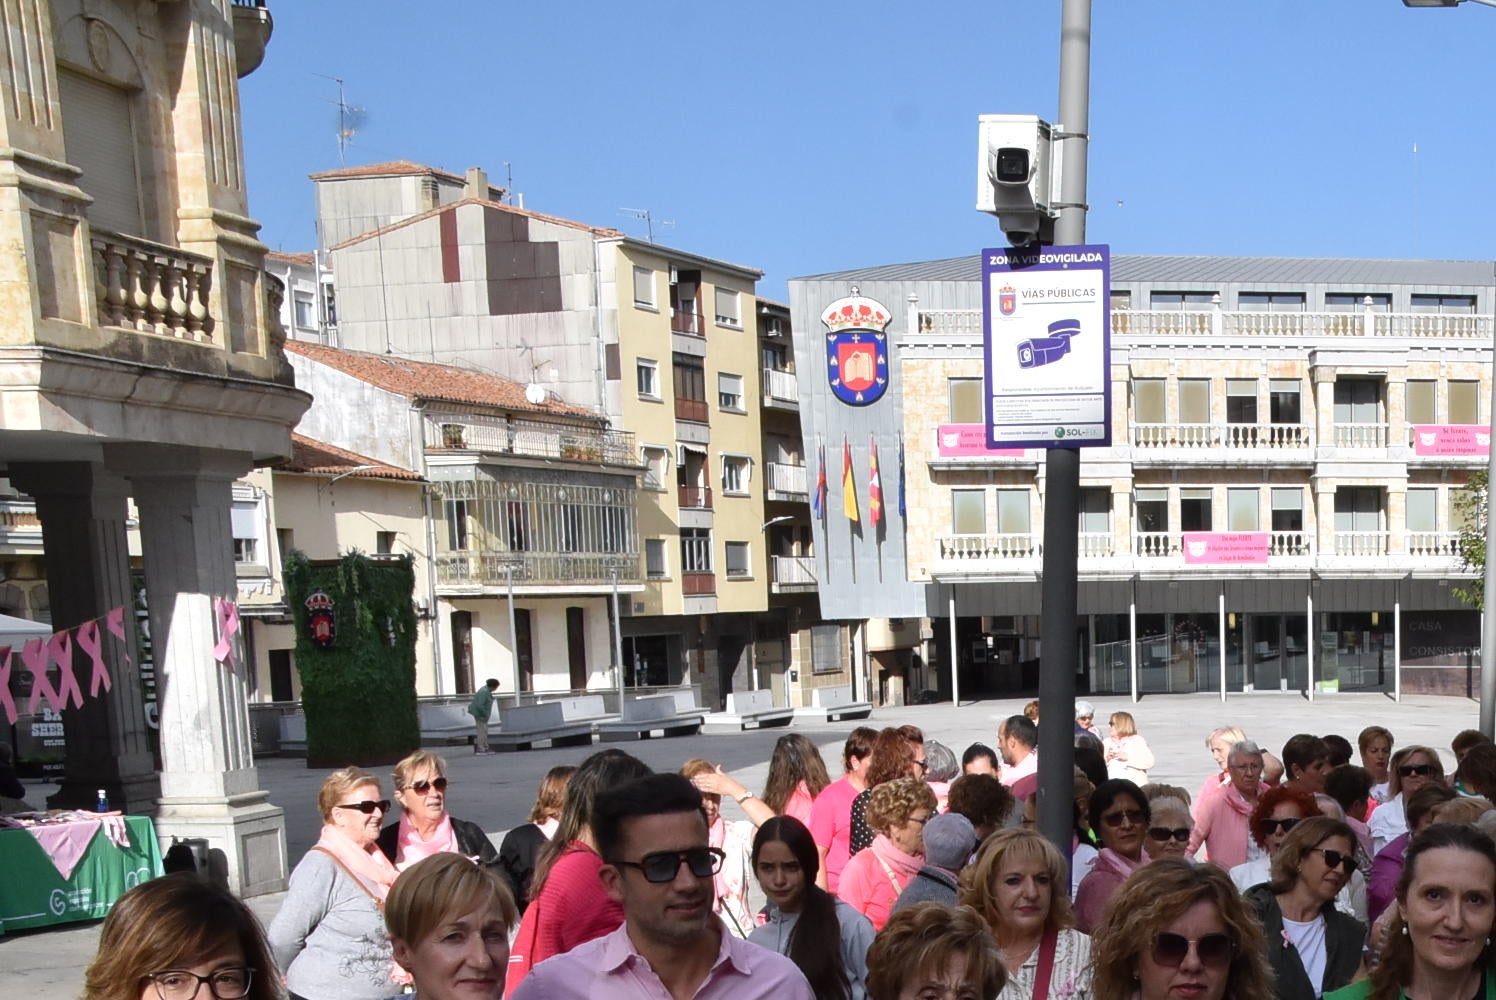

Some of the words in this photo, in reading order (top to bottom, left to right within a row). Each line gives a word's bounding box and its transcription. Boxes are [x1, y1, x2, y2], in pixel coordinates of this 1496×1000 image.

[990, 255, 1020, 265] ZONA
[1021, 252, 1103, 264] VIDEOVIGILADA
[1047, 287, 1096, 298] PÚBLICAS
[1409, 621, 1442, 631] CASA
